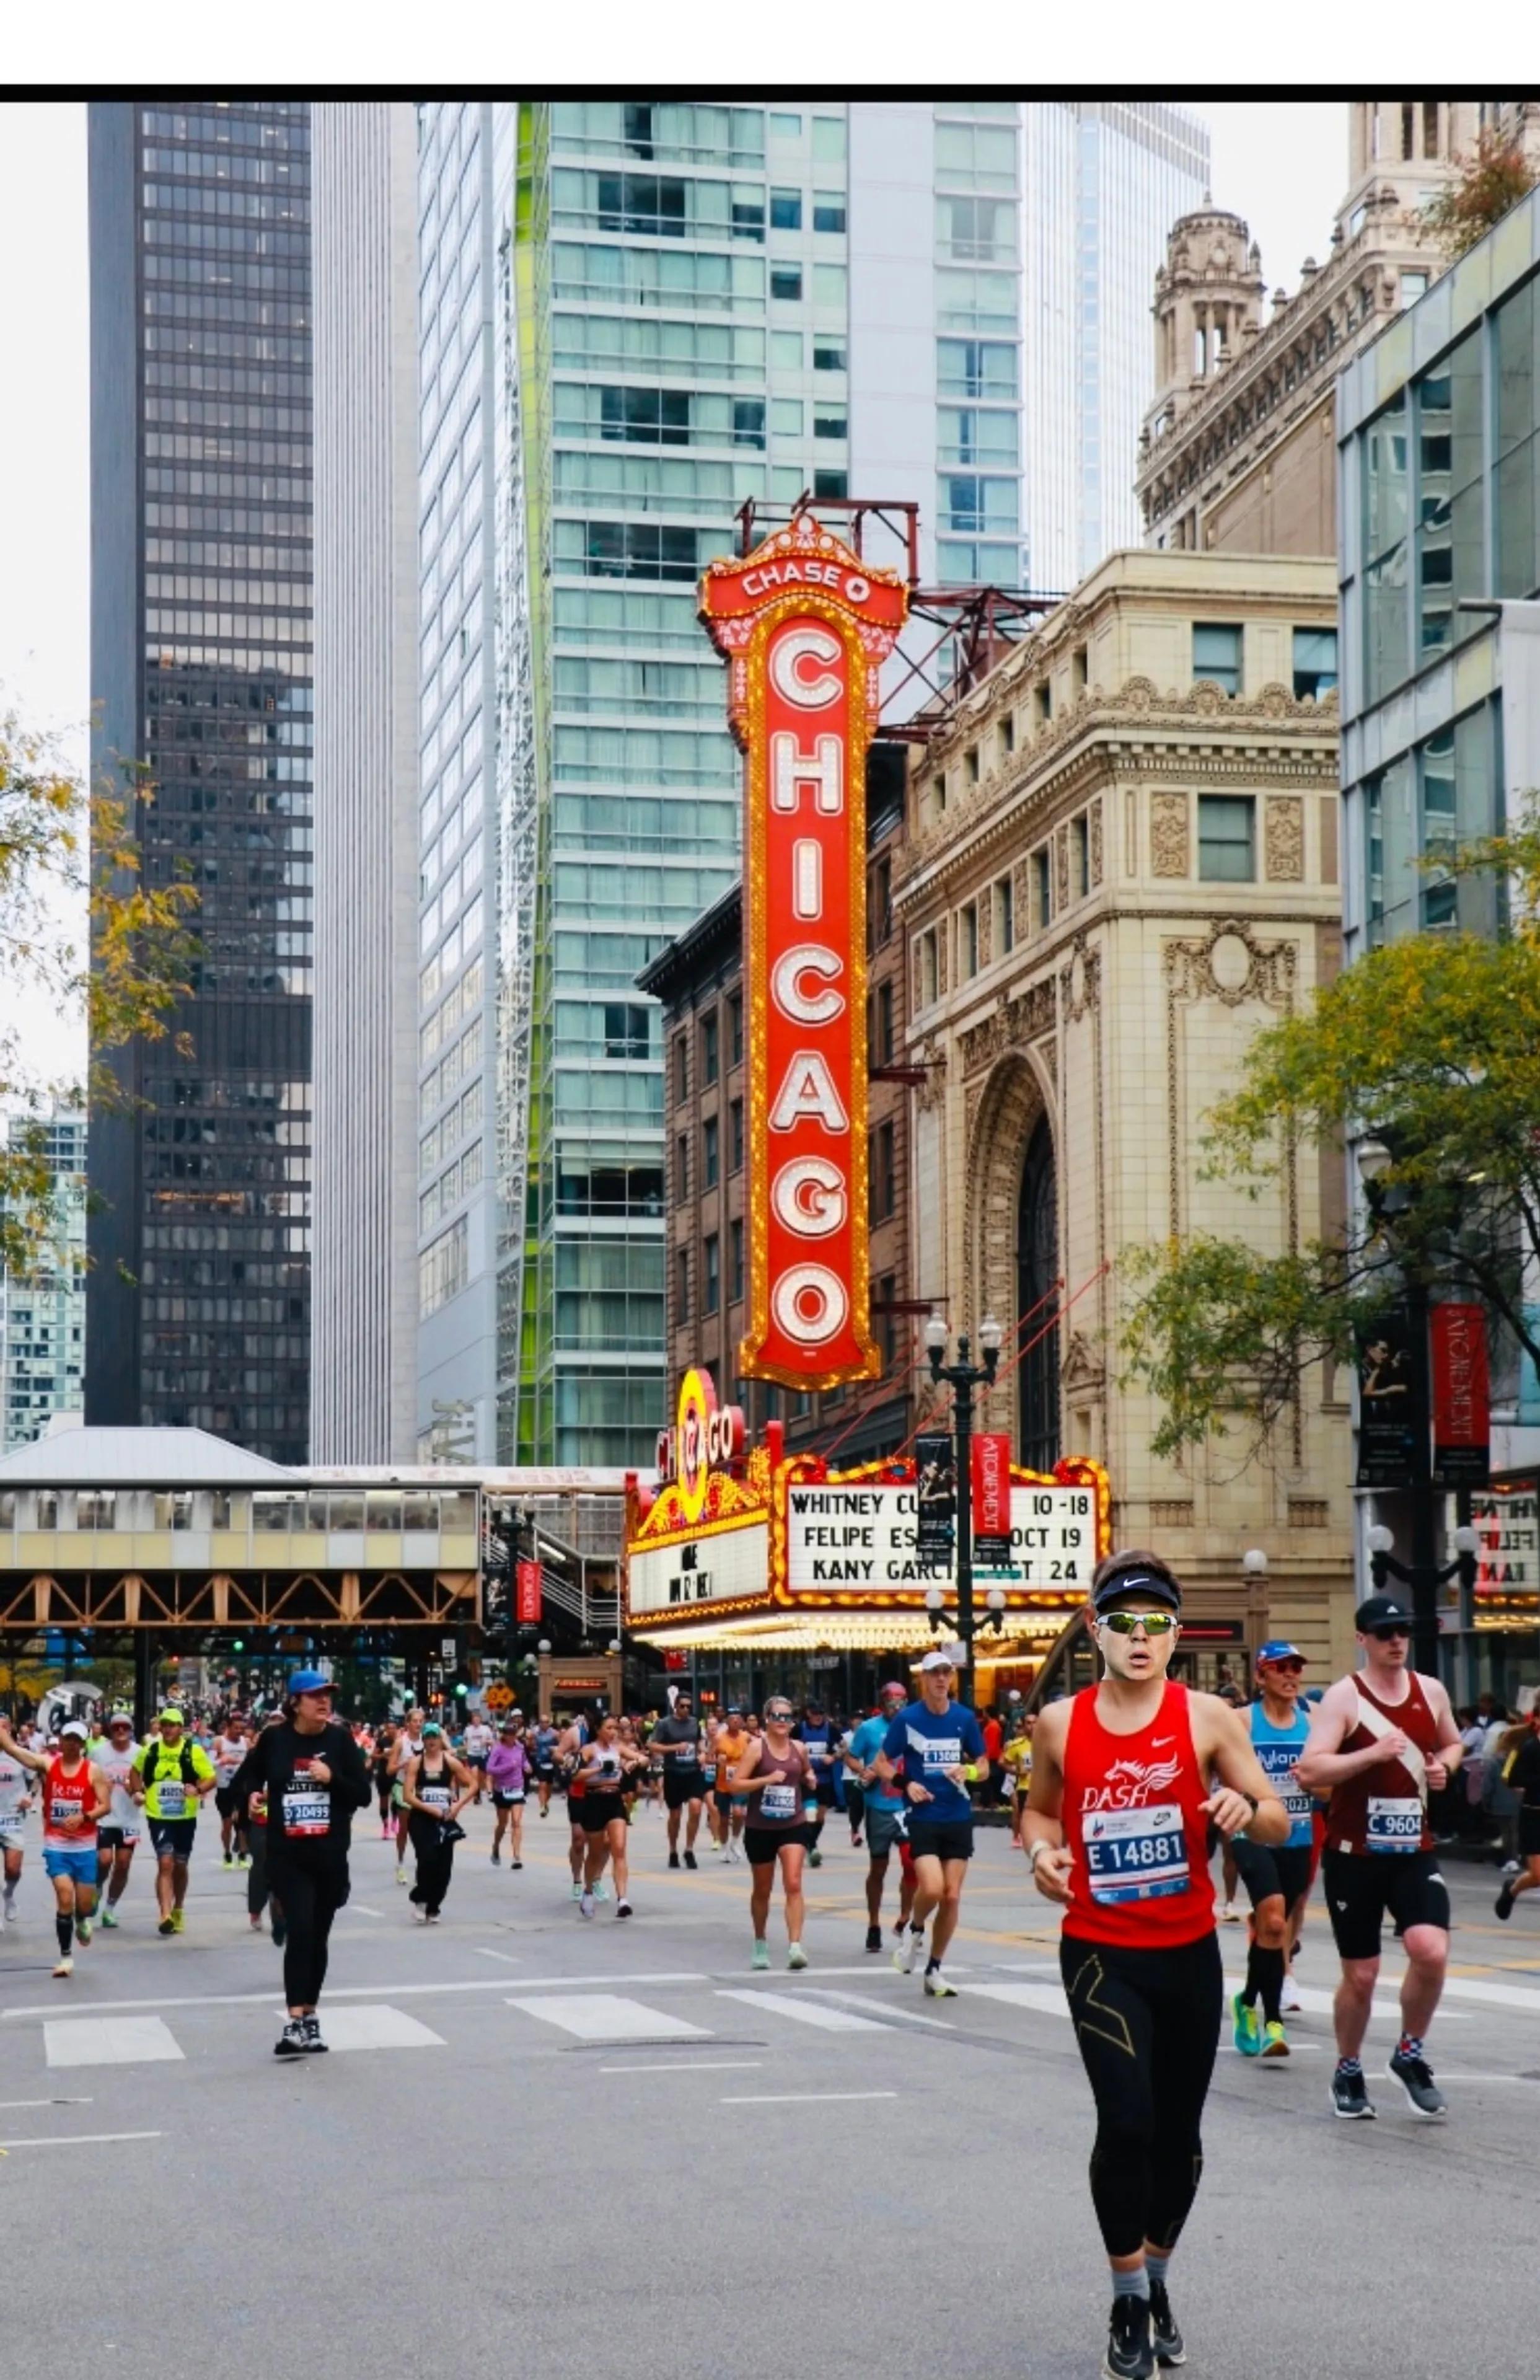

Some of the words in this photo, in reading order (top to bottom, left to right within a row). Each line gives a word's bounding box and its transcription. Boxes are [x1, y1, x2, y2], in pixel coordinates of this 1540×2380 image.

[742, 561, 842, 596] CHASE
[769, 628, 850, 1346] CHICAGO
[982, 1437, 999, 1531] ATONEMENT
[791, 1493, 883, 1515] WHITNEY
[804, 1527, 874, 1548] FELIPE
[1011, 1528, 1049, 1548] OCT
[1062, 1528, 1081, 1548] 19
[813, 1560, 874, 1580] KANY
[1050, 1560, 1078, 1580] 24
[1079, 1784, 1150, 1812] DASH
[1368, 1814, 1379, 1833] C
[1384, 1815, 1421, 1835] 9604
[1088, 1844, 1104, 1870] E
[1109, 1834, 1182, 1868] 14881
